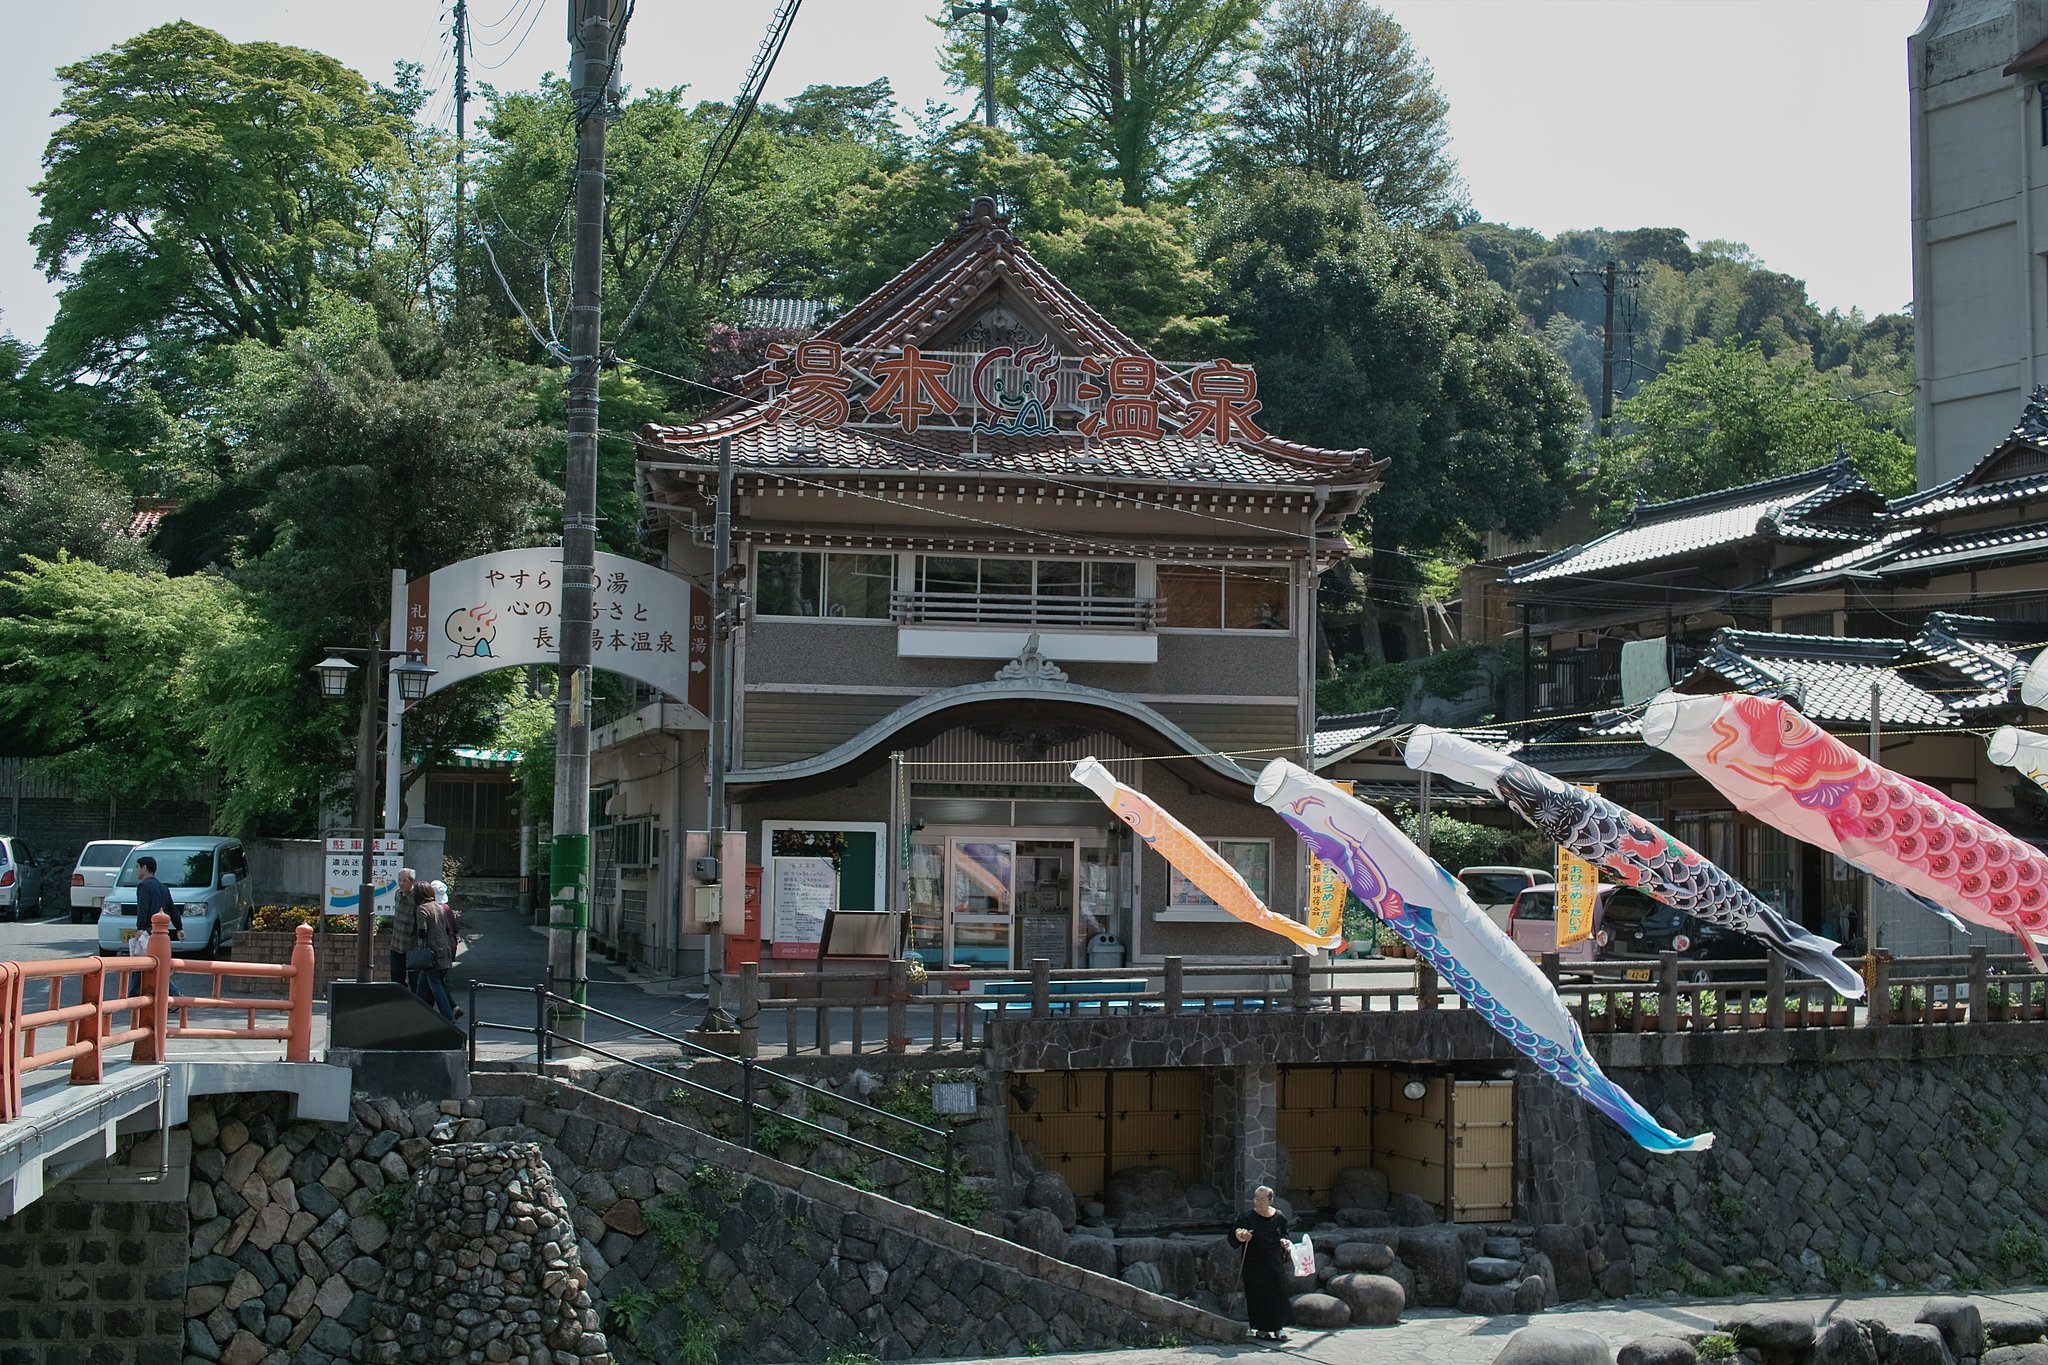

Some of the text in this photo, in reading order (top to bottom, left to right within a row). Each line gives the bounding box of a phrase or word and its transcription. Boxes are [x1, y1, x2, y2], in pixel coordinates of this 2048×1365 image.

[762, 339, 1271, 446] 湯本 温泉
[485, 568, 629, 595] やすら湯
[410, 603, 427, 642] 礼湯
[508, 601, 648, 622] 心のさと
[533, 626, 676, 652] 長湯本温泉
[691, 615, 708, 653] 恩湯
[332, 858, 398, 867] 違法迷駐車は
[332, 869, 393, 877] やめまょう。
